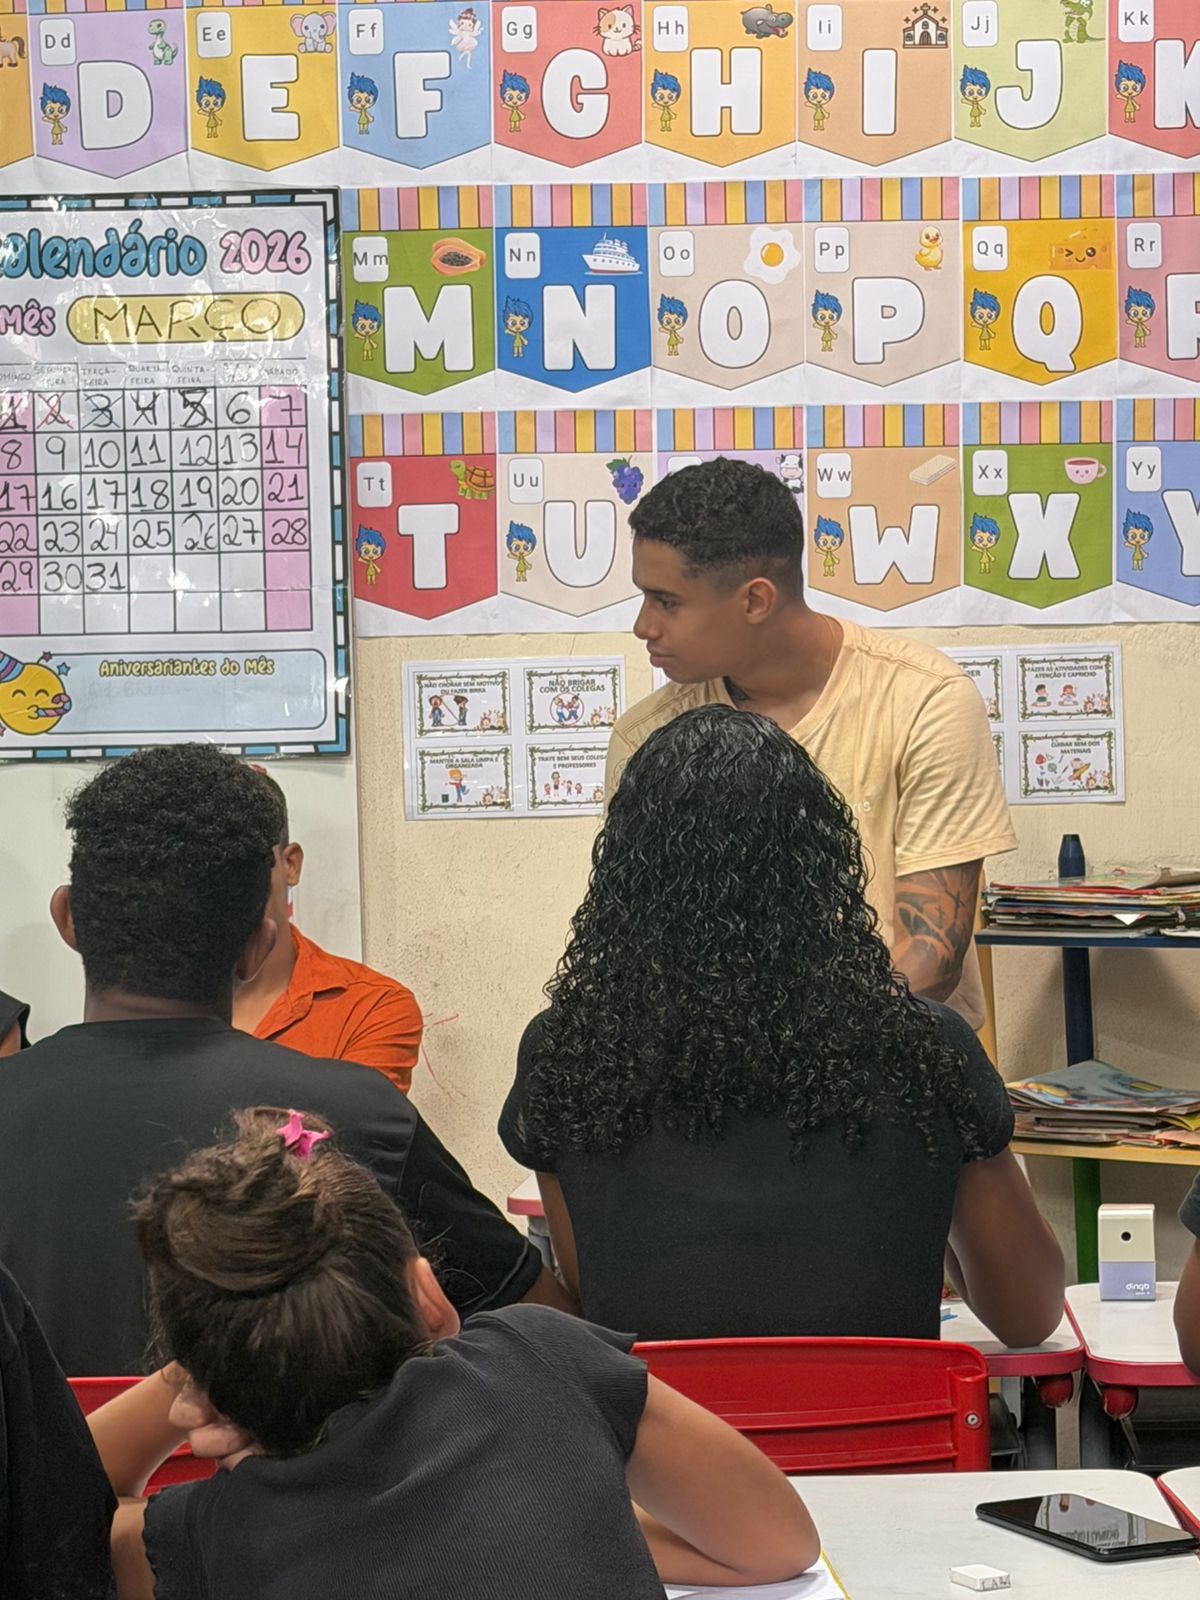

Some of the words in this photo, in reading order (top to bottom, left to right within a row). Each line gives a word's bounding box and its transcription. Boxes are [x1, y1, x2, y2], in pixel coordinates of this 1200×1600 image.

[240, 54, 300, 142] E
[393, 50, 452, 139] F
[541, 47, 610, 139] G
[690, 47, 762, 137] H
[862, 48, 897, 136] I
[994, 39, 1062, 129] J
[77, 61, 153, 150] D
[0, 219, 207, 279] alendário
[220, 228, 311, 275] 2026
[0, 298, 56, 337] Mês
[94, 299, 281, 343] MARÇO
[383, 283, 475, 374] M
[542, 283, 616, 370] N
[698, 279, 771, 369] O
[852, 277, 925, 364] P
[1011, 274, 1083, 373] Q
[84, 393, 114, 428] 3
[226, 391, 250, 425] 6
[269, 394, 302, 426] 7
[0, 439, 22, 470] 8
[46, 436, 66, 470] 9
[84, 437, 120, 468] 10
[130, 434, 166, 466] 11
[179, 434, 218, 466] 12
[220, 433, 258, 465] 13
[265, 429, 303, 464] 14
[40, 482, 77, 511] 16
[87, 477, 126, 509] 17
[131, 477, 170, 512] 18
[180, 476, 214, 508] 19
[221, 476, 260, 505] 20
[267, 472, 304, 503] 21
[0, 521, 37, 553] 22
[43, 521, 81, 553] 23
[89, 518, 120, 551] 24
[133, 519, 172, 549] 25
[181, 512, 217, 551] 26
[222, 514, 261, 546] 27
[271, 518, 308, 545] 28
[397, 502, 460, 590] T
[543, 500, 616, 588] U
[848, 504, 940, 585] W
[1007, 492, 1081, 580] X
[0, 560, 33, 592] 29
[43, 561, 82, 592] 30
[86, 562, 125, 590] 31
[99, 657, 216, 677] Aniversariantes
[220, 656, 239, 676] do
[245, 655, 275, 675] Mês
[549, 678, 566, 686] NÃO
[560, 685, 570, 693] OS
[571, 684, 605, 692] COLEGAS
